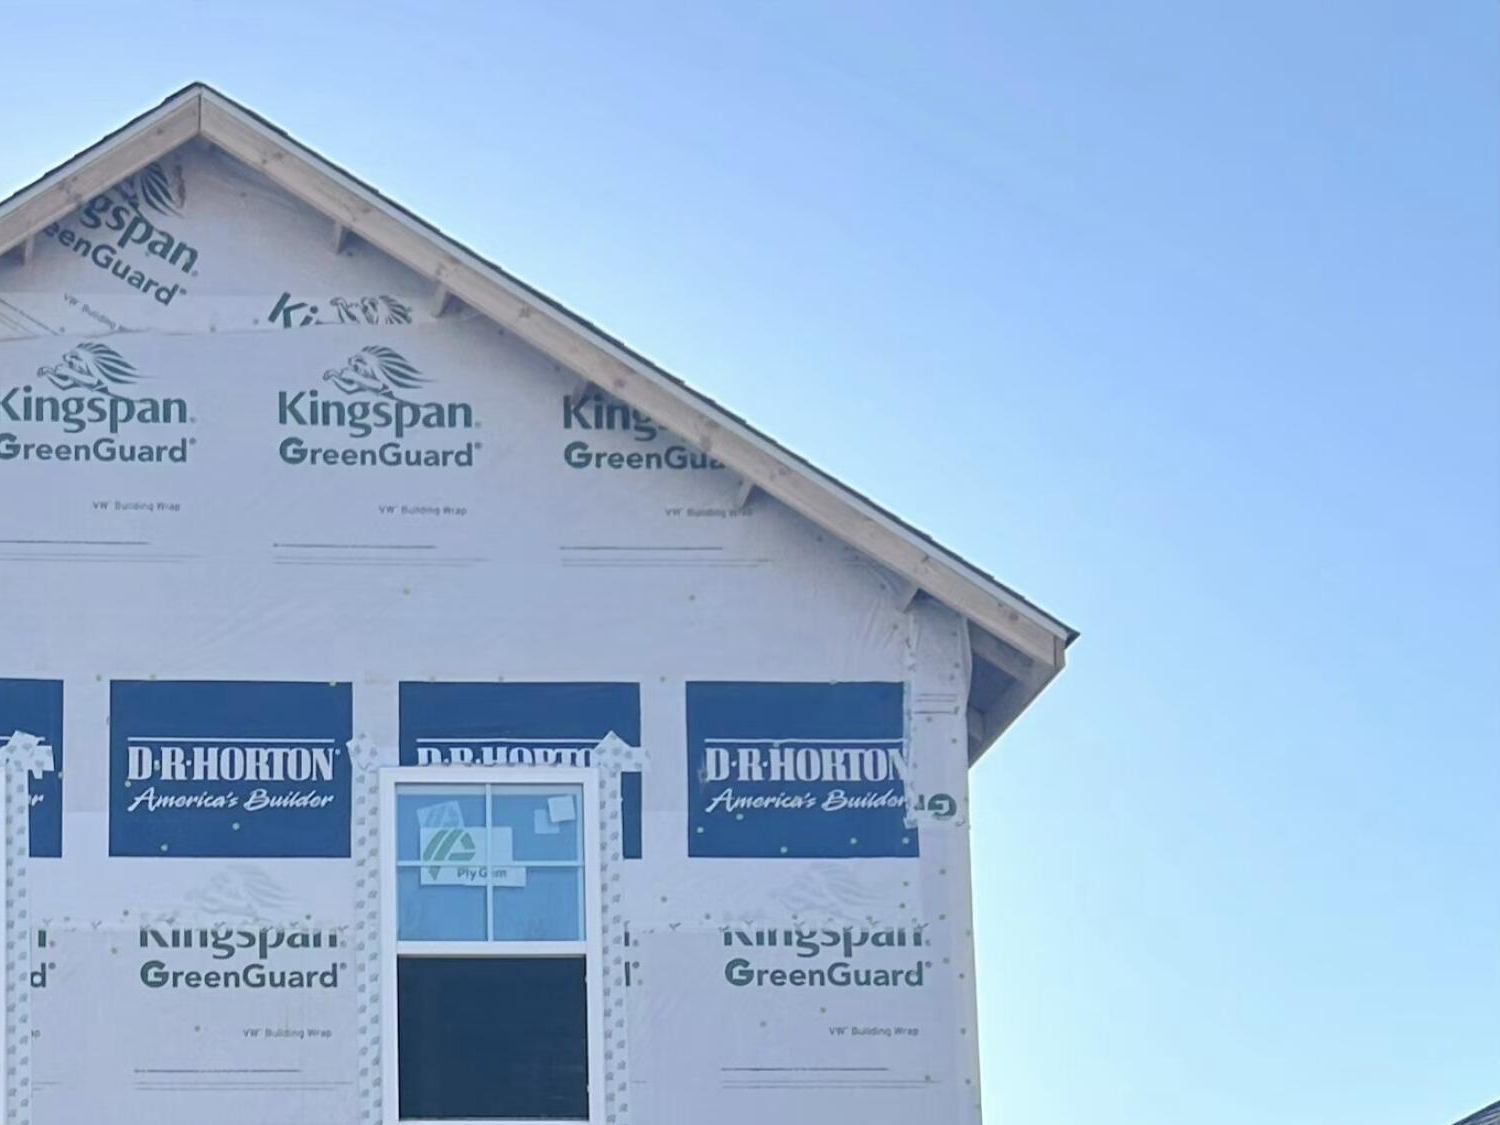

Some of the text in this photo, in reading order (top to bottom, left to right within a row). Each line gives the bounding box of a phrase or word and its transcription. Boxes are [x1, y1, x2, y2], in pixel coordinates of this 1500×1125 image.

[79, 195, 198, 274] gspan
[43, 221, 180, 306] eenGuard
[278, 390, 473, 438] Kingspan
[563, 394, 660, 442] King
[279, 437, 473, 467] GreenGuard
[564, 441, 725, 470] GreenGua
[127, 786, 334, 812] America's Builder
[705, 788, 817, 812] America's
[821, 789, 907, 812] Builder
[140, 960, 337, 989] GreenGuard
[724, 958, 923, 987] GreenGuard
[265, 1029, 303, 1039] Building
[307, 1029, 332, 1039] Wrap
[851, 1026, 891, 1038] Building
[894, 1026, 919, 1037] Wrap
